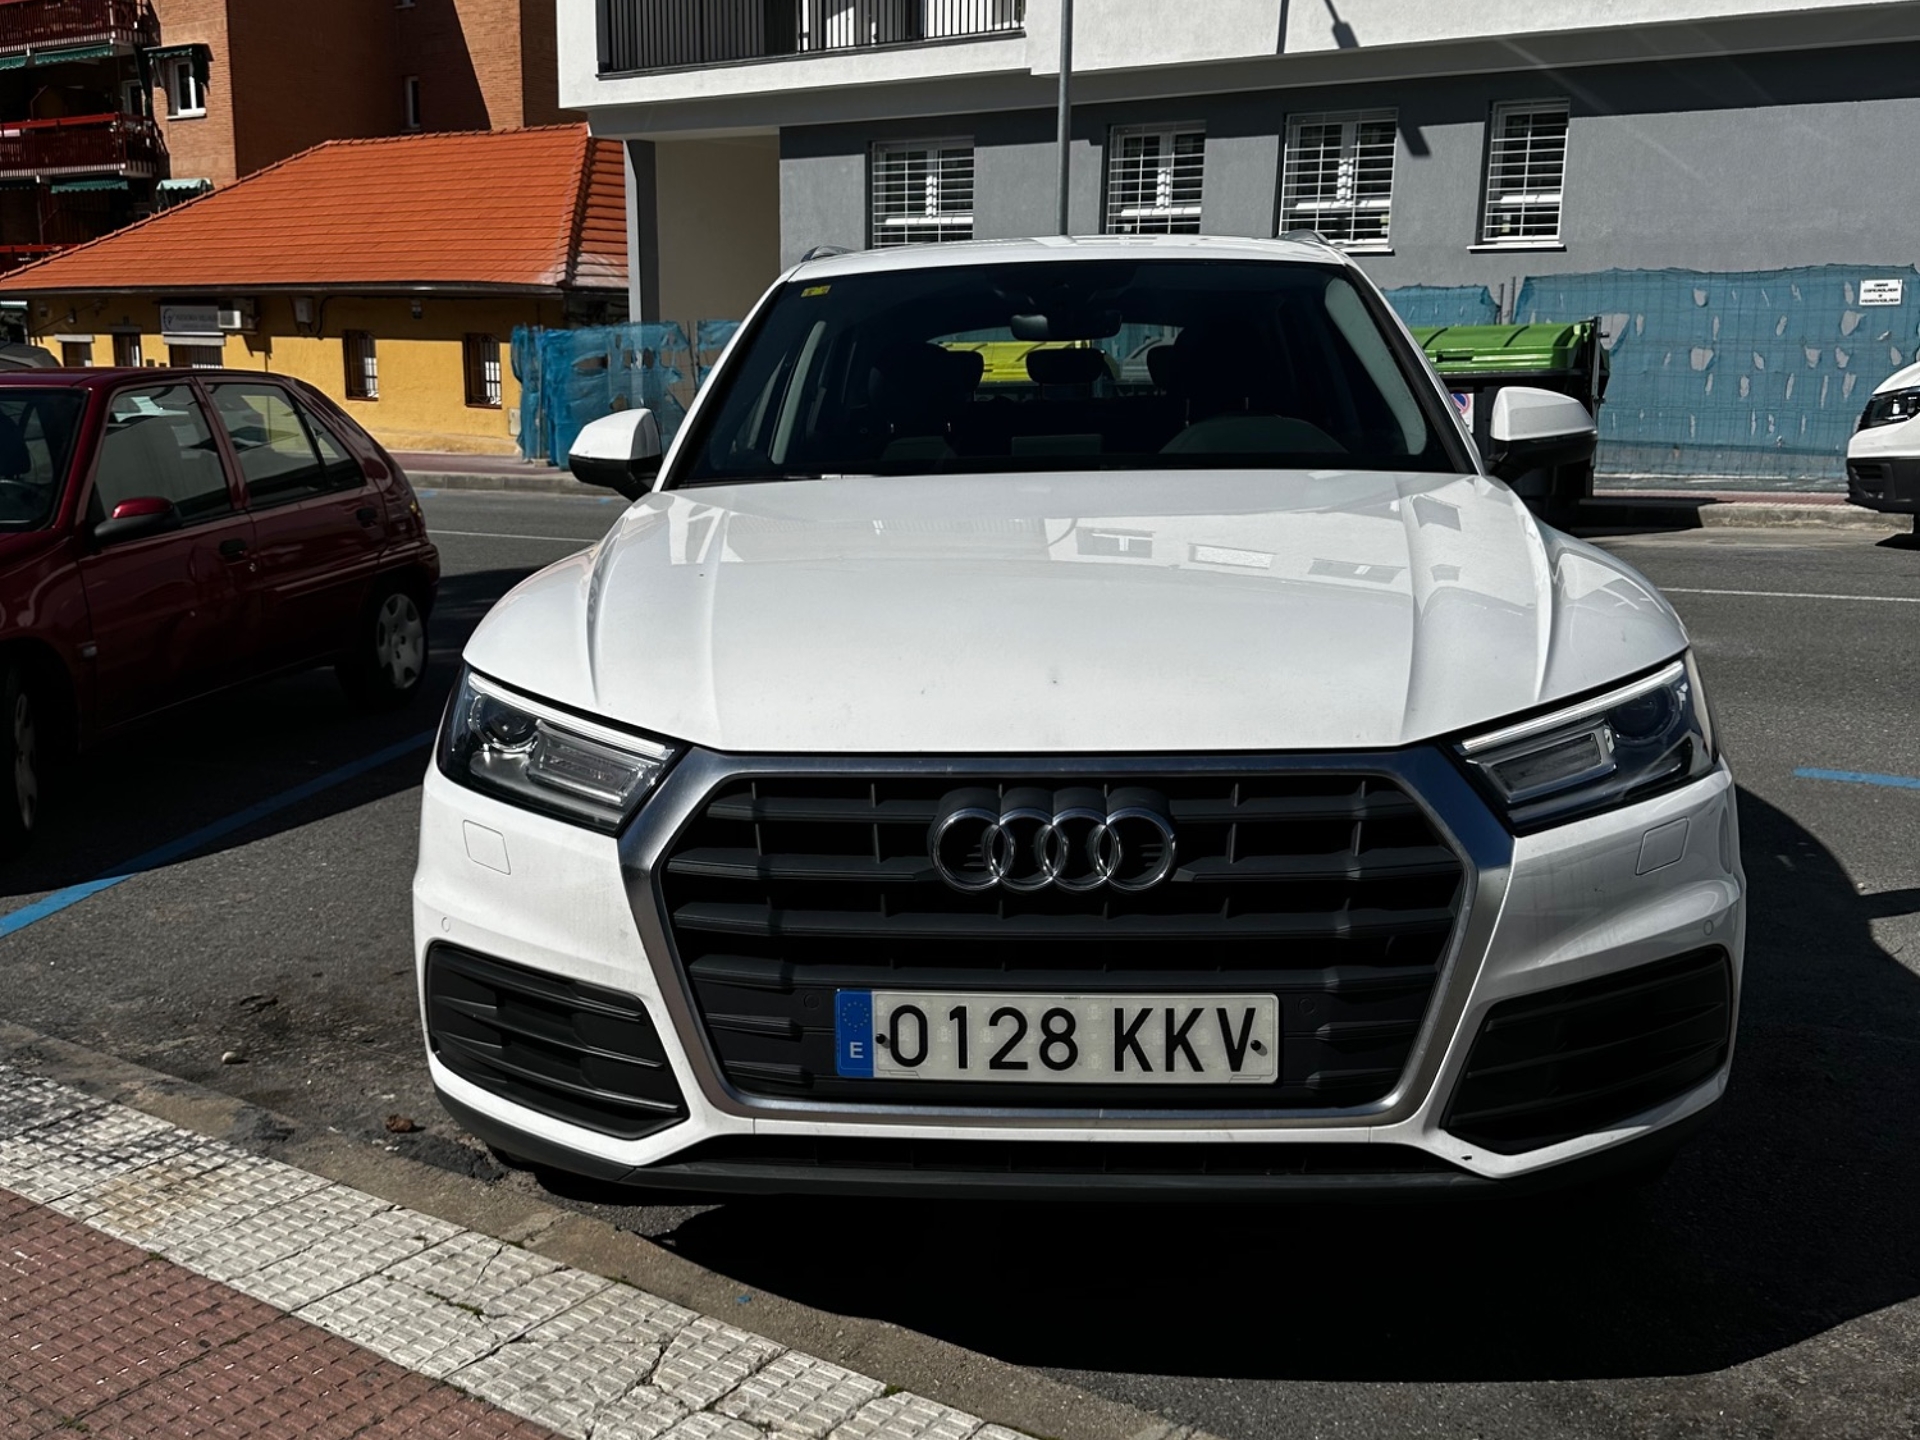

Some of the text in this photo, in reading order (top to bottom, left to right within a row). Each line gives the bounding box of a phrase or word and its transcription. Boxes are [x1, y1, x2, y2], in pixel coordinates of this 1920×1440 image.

[849, 1041, 864, 1059] E
[889, 1004, 1257, 1073] 0128 KKV
